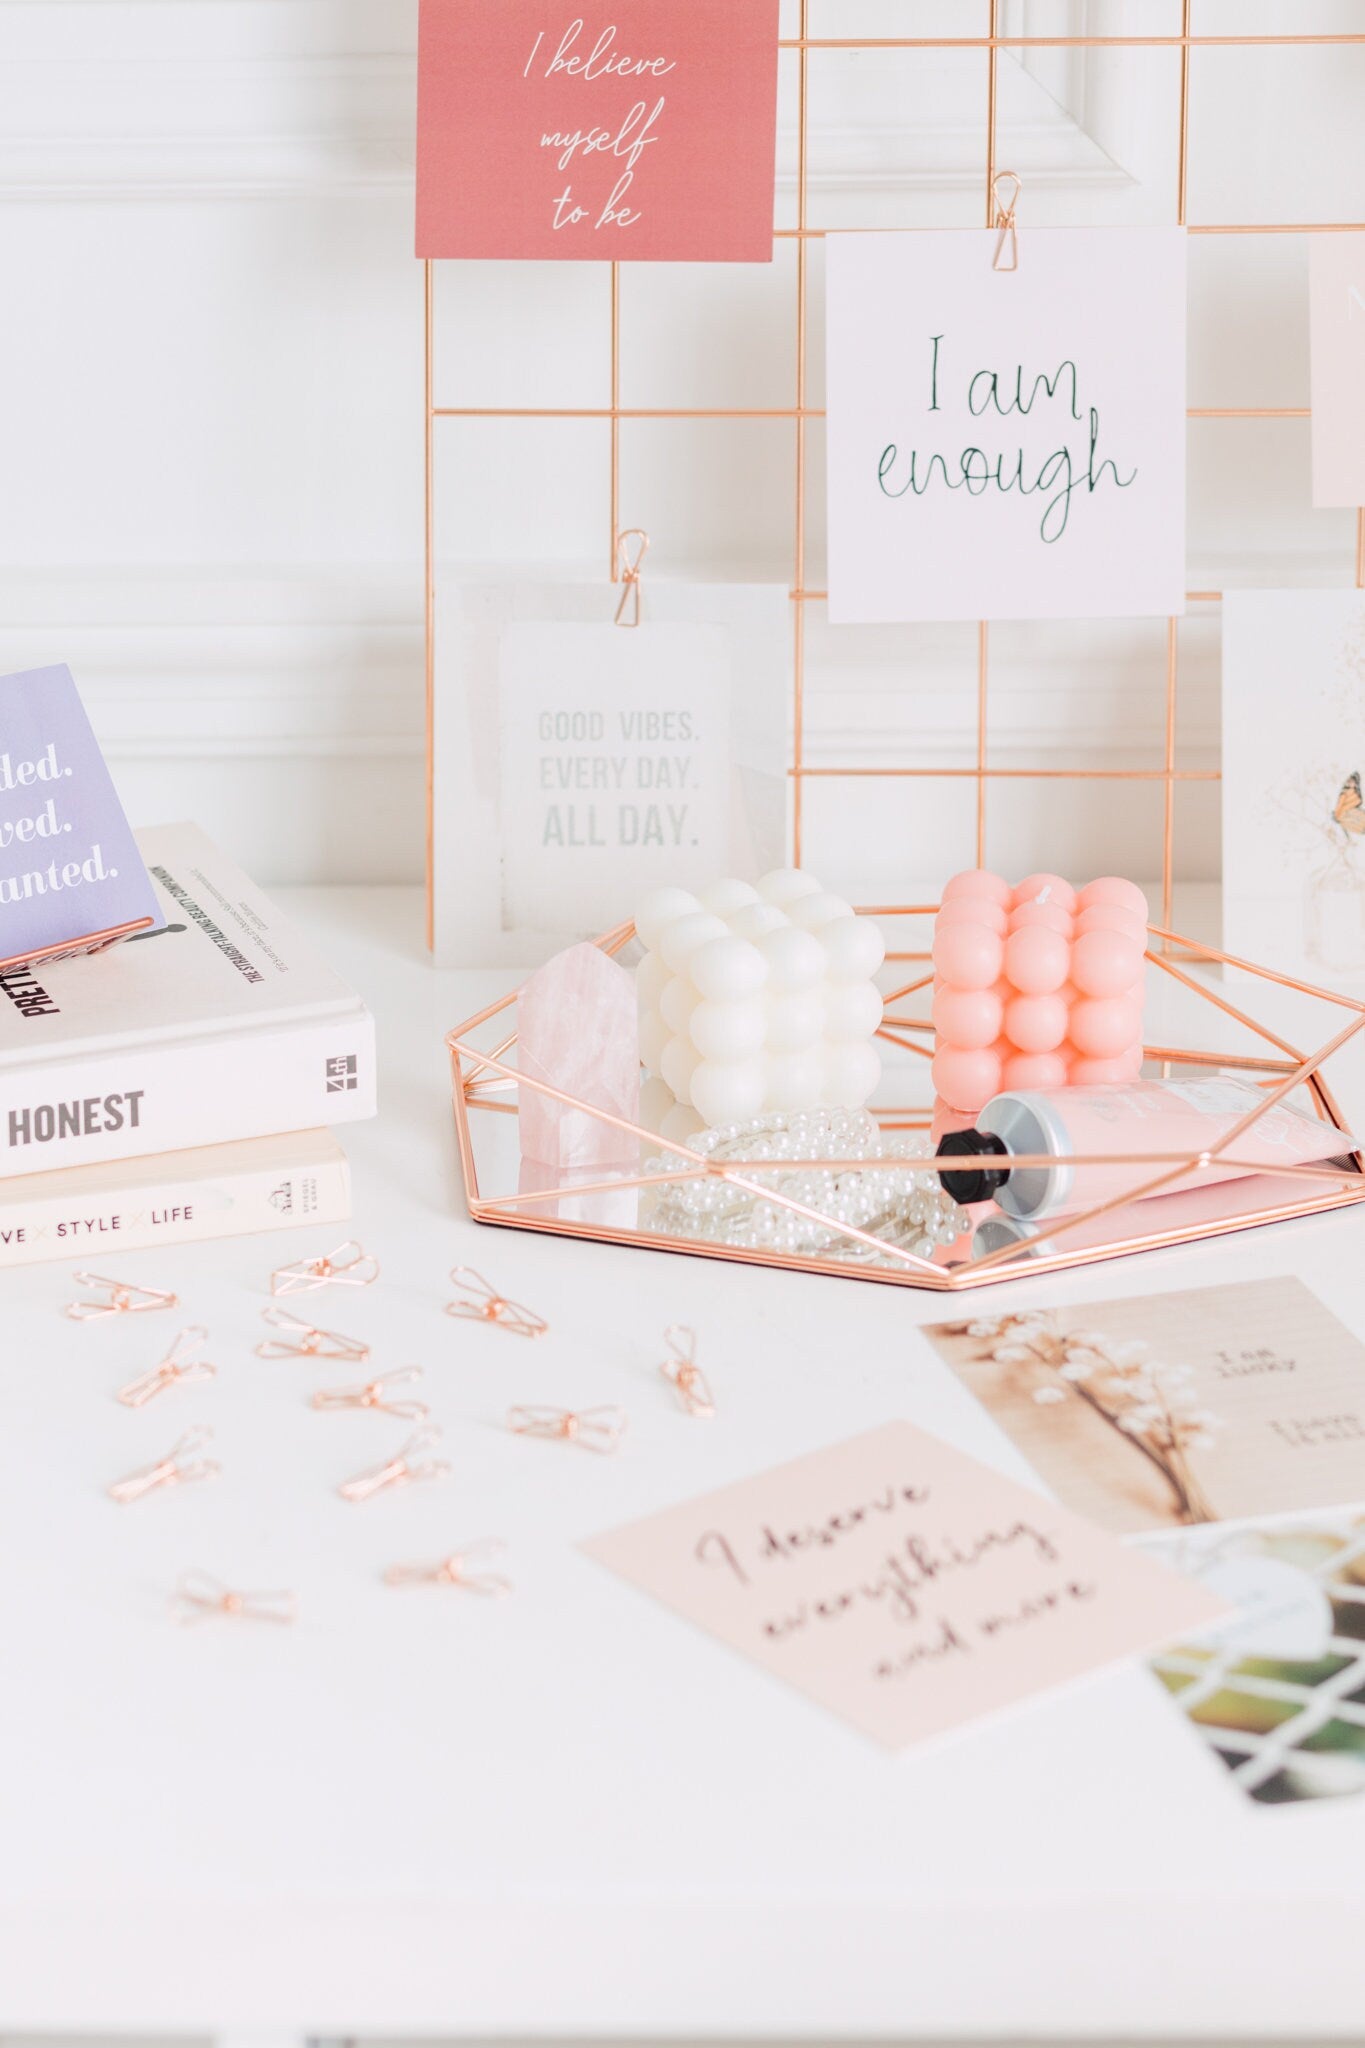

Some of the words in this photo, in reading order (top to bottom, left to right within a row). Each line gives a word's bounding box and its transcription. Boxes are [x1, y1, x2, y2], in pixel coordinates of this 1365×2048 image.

[523, 32, 545, 78] I
[545, 18, 677, 81] believe
[540, 96, 666, 171] myself
[552, 185, 589, 231] to
[594, 171, 642, 231] be
[928, 334, 944, 412] I
[968, 360, 1082, 420] am
[877, 407, 1138, 544] enough
[538, 710, 604, 742] GOOD
[620, 710, 700, 742] VIBES.
[540, 756, 627, 790] EVERY
[636, 756, 699, 790] DAY.
[542, 804, 606, 847] ALL
[619, 804, 700, 847] DAY.
[177, 898, 207, 921] BEAUTY
[196, 919, 256, 974] STRAIGHT-TALKING
[242, 970, 265, 984] THE
[8, 1090, 144, 1147] HONEST
[57, 1215, 121, 1238] STYLE
[151, 1205, 194, 1225] LIFE
[693, 1528, 753, 1590] I
[759, 1482, 932, 1562] deserve
[761, 1521, 1060, 1623] everything
[871, 1614, 974, 1682] and
[978, 1577, 1097, 1637] more
